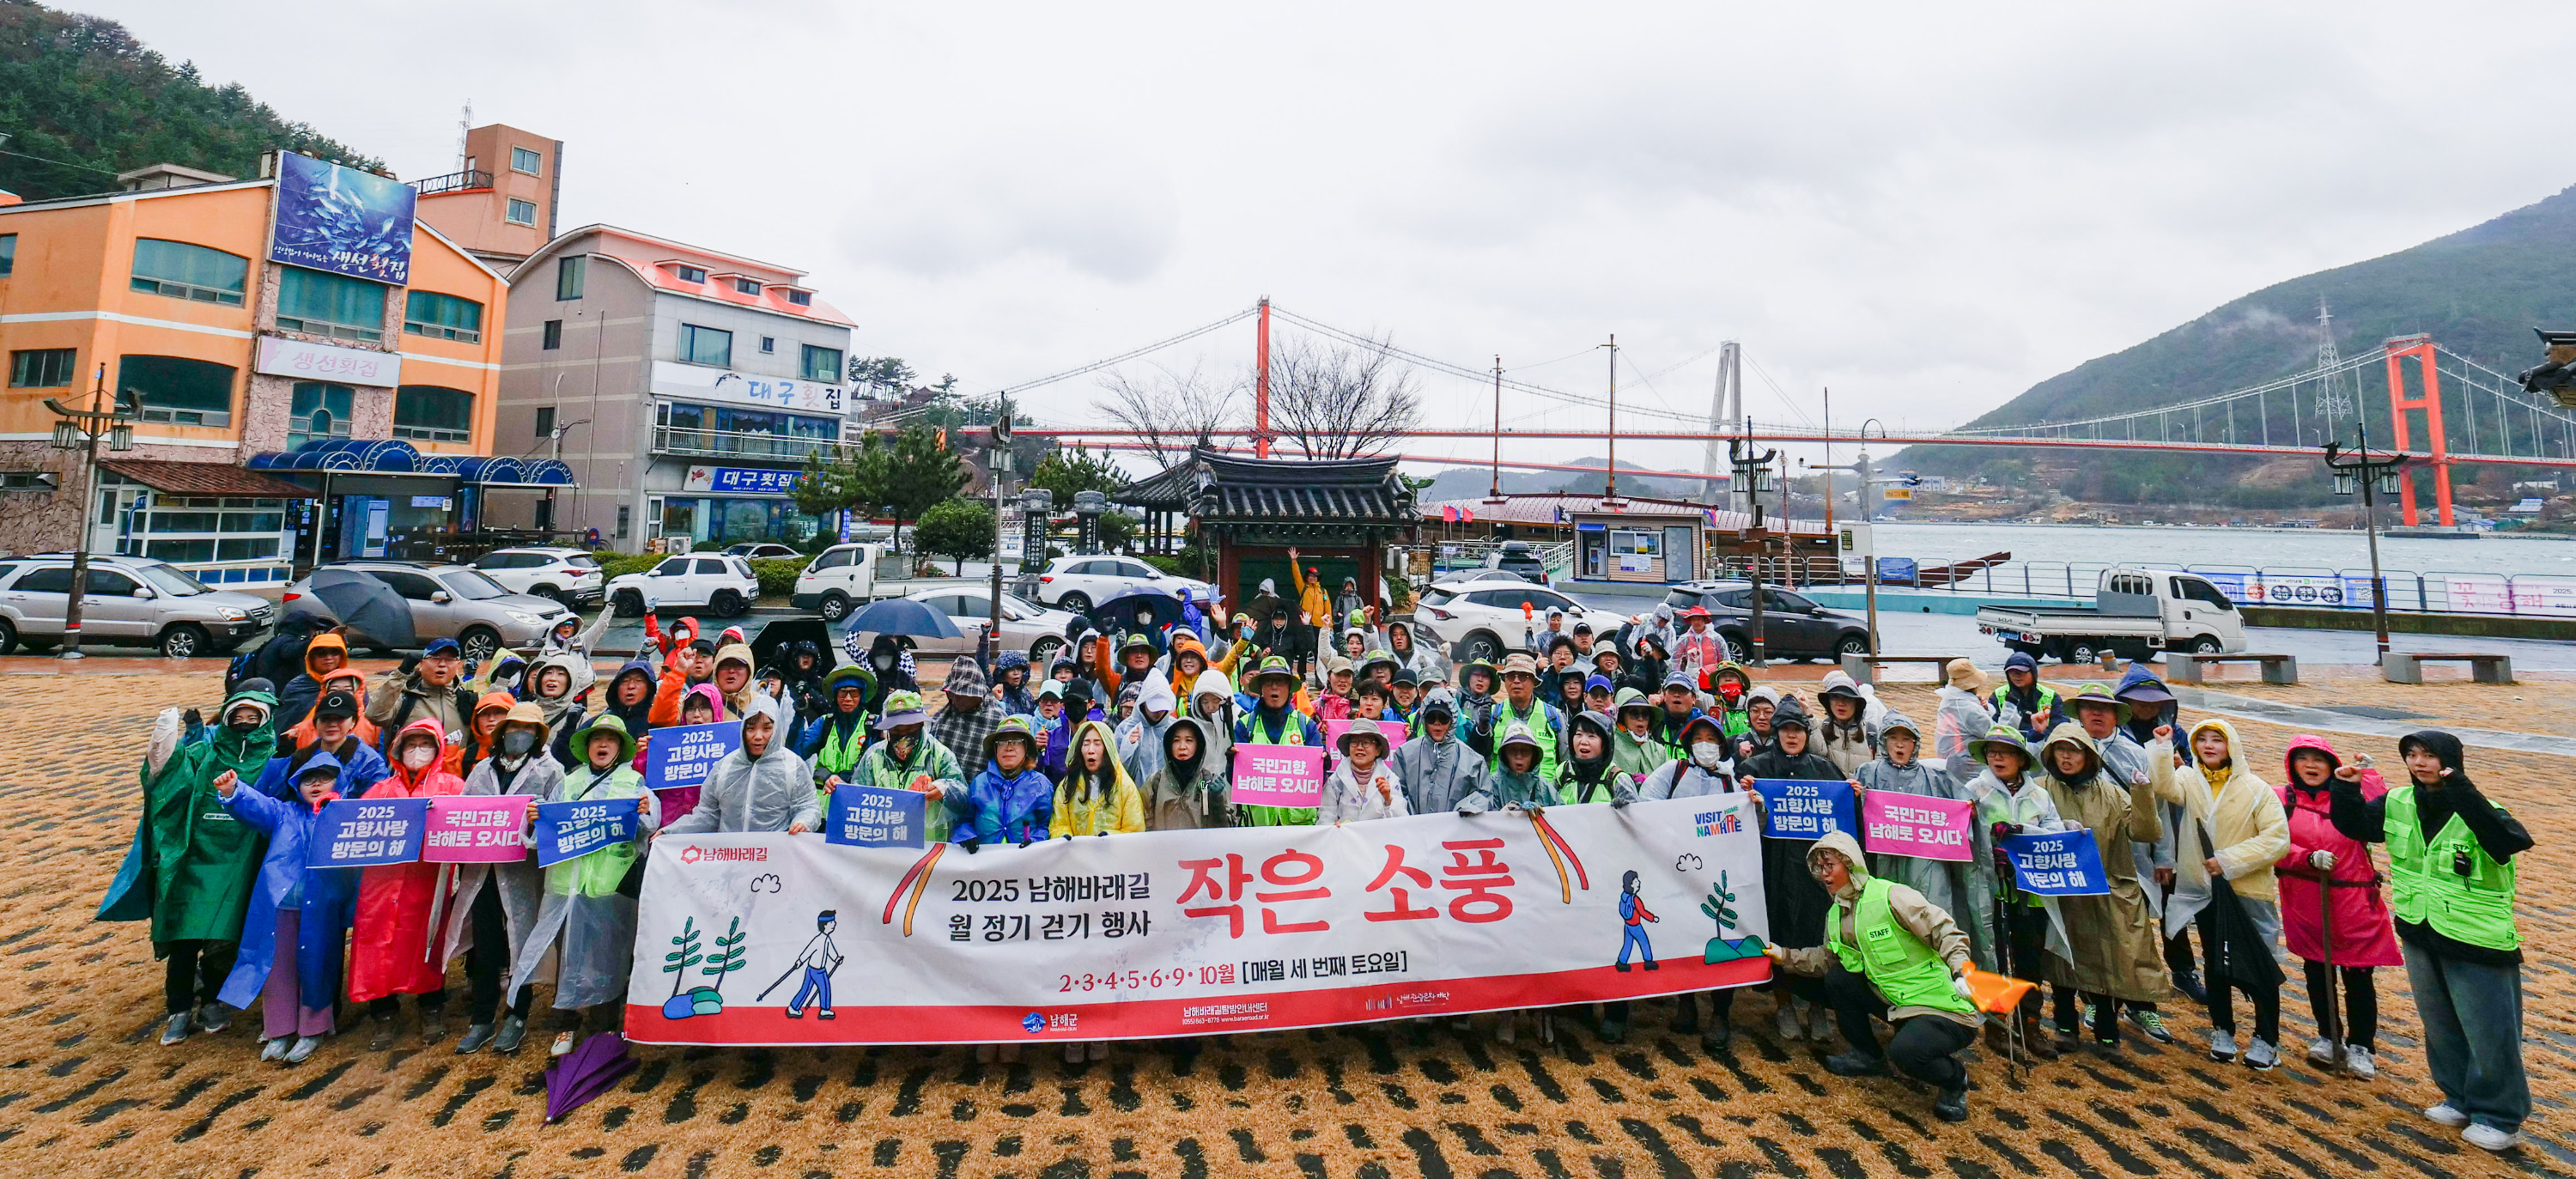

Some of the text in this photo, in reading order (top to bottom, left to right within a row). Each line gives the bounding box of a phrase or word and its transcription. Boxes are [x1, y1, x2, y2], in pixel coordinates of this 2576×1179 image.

[332, 250, 405, 281] 생선횟집
[292, 351, 379, 378] 생선횟집
[748, 380, 841, 410] 대구횟집
[722, 471, 793, 487] 대구횟집
[682, 730, 714, 744] 2025
[667, 742, 726, 763] 고향사랑
[665, 762, 708, 781] 방문의
[1252, 757, 1309, 776] 국민고향,
[1237, 775, 1319, 794] 남해로 오시다
[1785, 785, 1820, 798] 2025
[860, 793, 893, 808] 2025
[1773, 797, 1833, 815] 고향사랑
[358, 805, 395, 819] 2025
[446, 810, 512, 827] 국민고향,
[571, 805, 606, 819] 2025
[846, 806, 905, 823] 고향사랑
[1694, 811, 1722, 825] VISIT
[1884, 805, 1949, 828] 국민고향,
[337, 819, 408, 840] 고향사랑
[1774, 814, 1837, 833] 방문의 해
[428, 830, 522, 847] 남해로 오시다
[557, 825, 606, 854] 방문의
[844, 824, 907, 842] 방문의 해
[1870, 822, 1963, 847] 남해로 오시다
[331, 839, 404, 860] 방문의 해
[703, 848, 768, 862] 남해바래길
[2032, 840, 2064, 853] 2025
[2018, 852, 2077, 870] 고향사랑
[951, 873, 1151, 904] 2025 남해바래길
[1176, 837, 1516, 939] 작은 소풍
[2022, 871, 2087, 888] 방문의 해
[949, 909, 1151, 943] 월 정기 걷기 행사
[1869, 927, 1890, 939] STAFF
[1242, 957, 1285, 984] [매월
[1290, 957, 1308, 980] 세
[1312, 955, 1346, 979] 번째
[1351, 950, 1409, 975] 토요일]
[1183, 1002, 1268, 1018] 남해바래길탐방안내센터
[1049, 1013, 1078, 1027] 남해군
